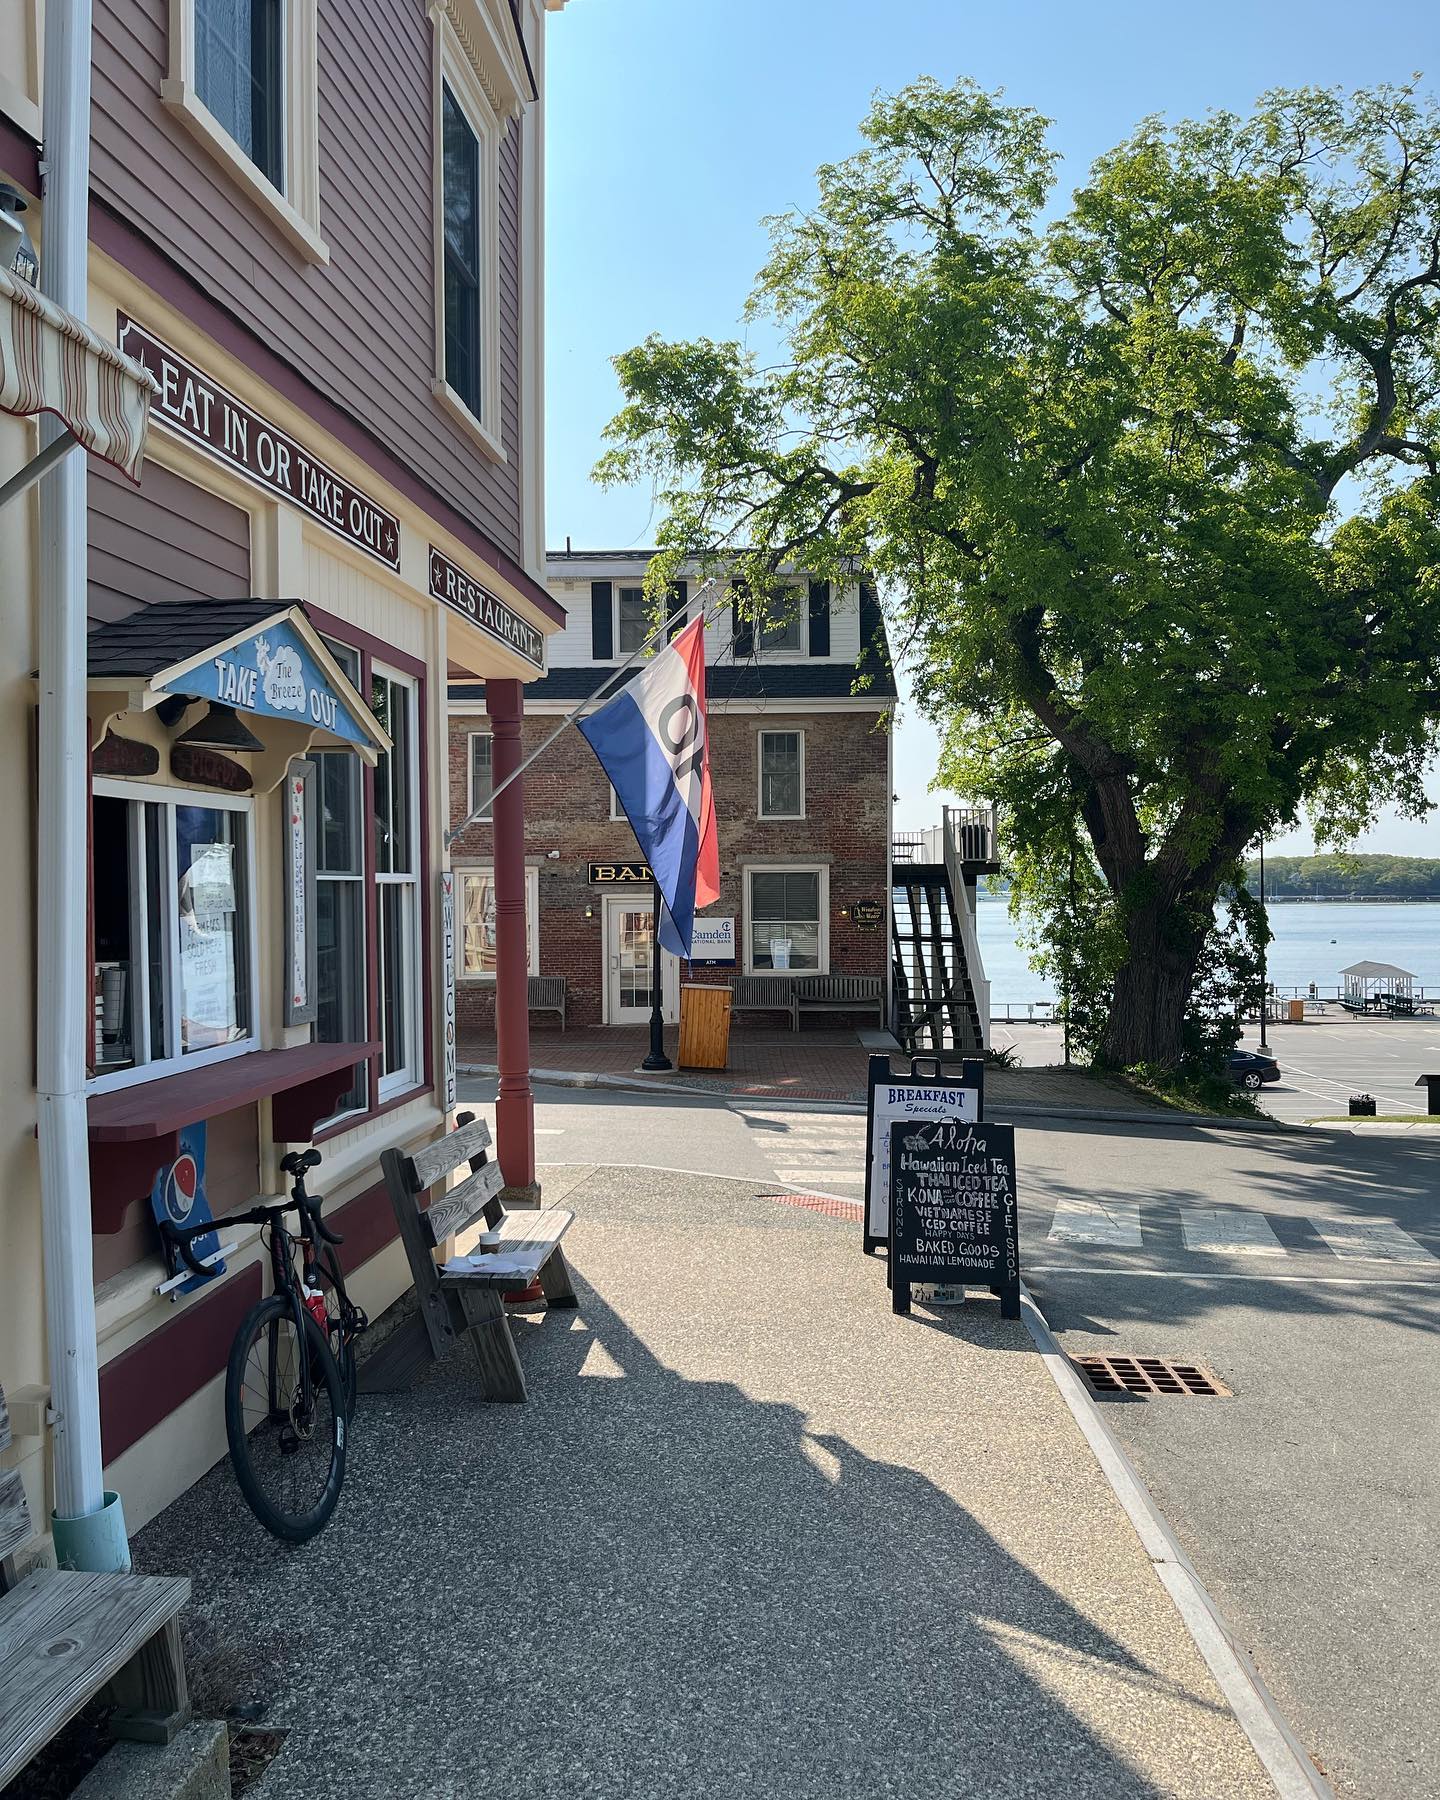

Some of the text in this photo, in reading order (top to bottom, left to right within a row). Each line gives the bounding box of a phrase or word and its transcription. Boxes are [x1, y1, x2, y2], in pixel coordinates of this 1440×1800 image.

[161, 358, 384, 550] EAT IN OR TAKE OUT
[446, 567, 535, 654] RESTAURANT
[276, 659, 292, 679] The
[214, 658, 337, 731] TAKE OUT
[270, 683, 302, 700] Breeze
[595, 866, 654, 881] BAN
[691, 929, 731, 939] Camden
[444, 905, 455, 1105] WELCOME
[888, 1088, 965, 1108] BREAKFAST
[904, 1103, 947, 1114] Specials
[929, 1126, 987, 1156] Aloha
[900, 1153, 1010, 1176] Hawaiian Iced Tea
[915, 1172, 1009, 1192] THAI ICED TEA
[896, 1178, 904, 1237] STRONG
[907, 1187, 944, 1206] KONA
[955, 1191, 999, 1209] COFFEE
[915, 1205, 992, 1223] VIETNAMESE
[921, 1219, 990, 1235] ICED COFFEE
[925, 1229, 975, 1241] HAPPY DAYS
[1003, 1193, 1017, 1280] GIFT SHOP
[916, 1238, 1000, 1257] BAKED GOODS
[899, 1254, 996, 1269] HAWAIIAN LEMONADE
